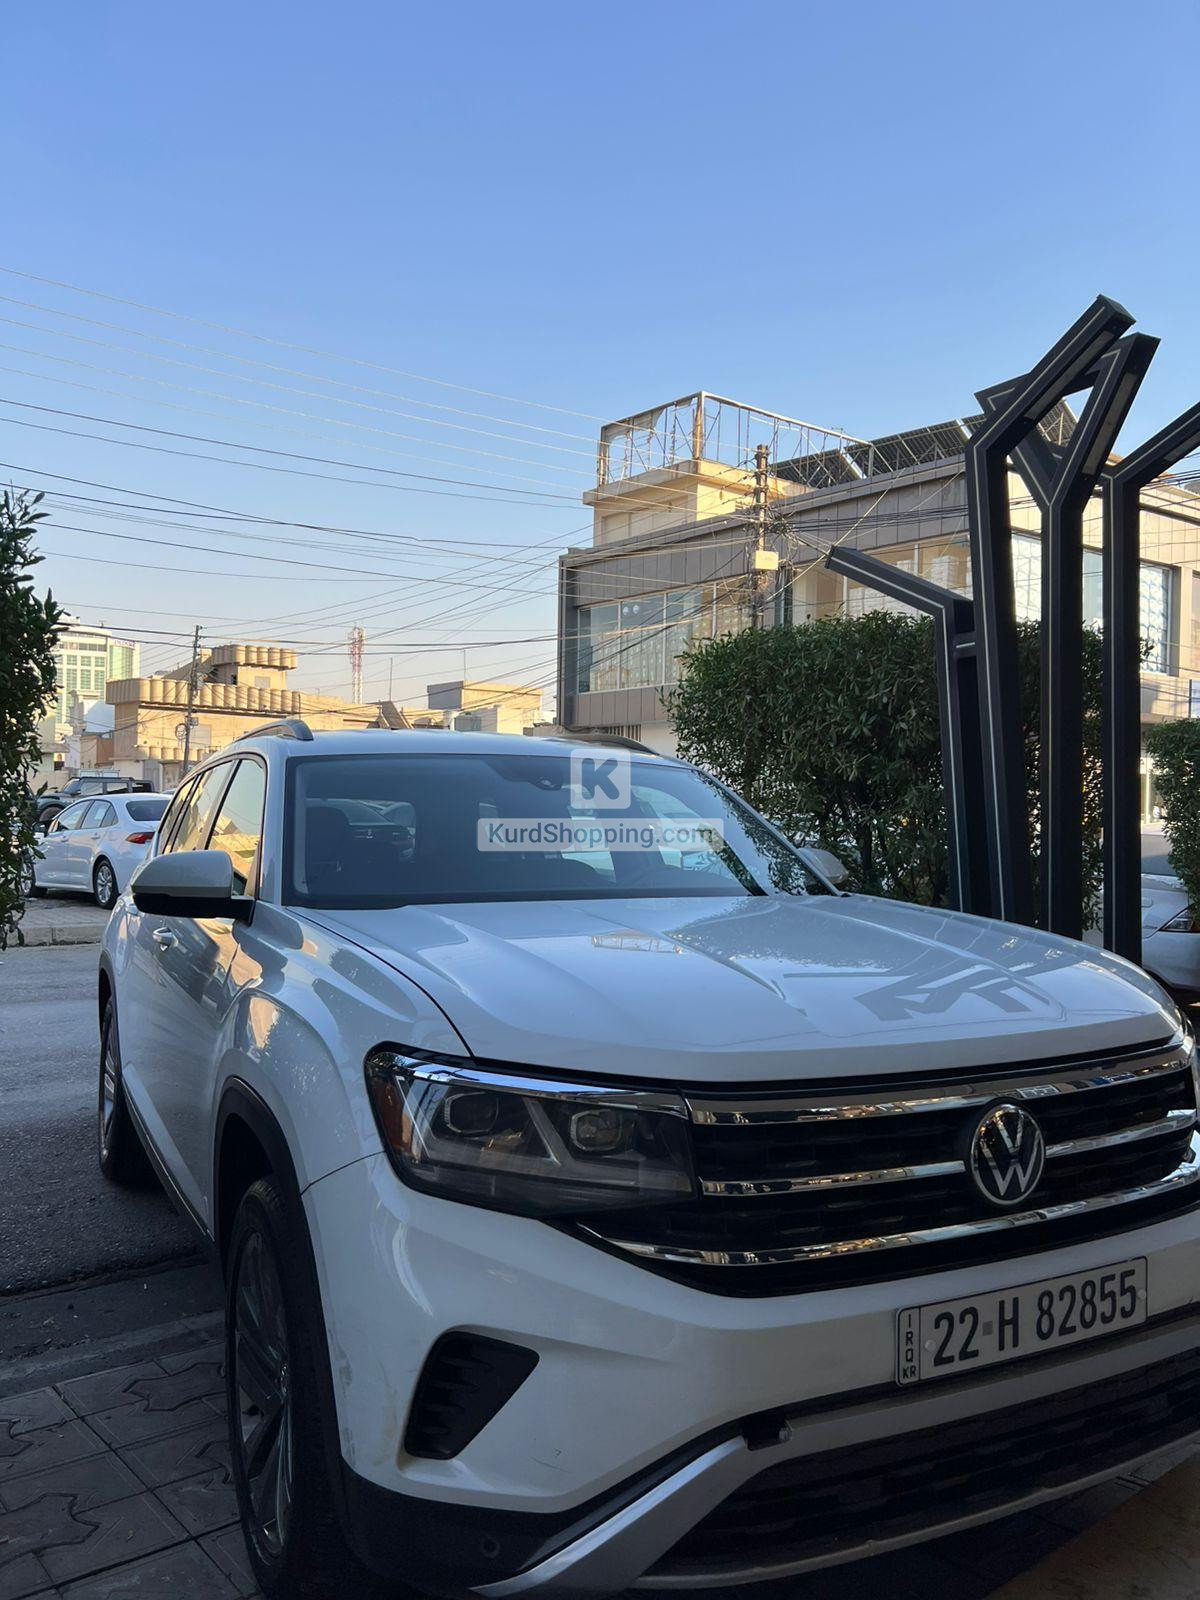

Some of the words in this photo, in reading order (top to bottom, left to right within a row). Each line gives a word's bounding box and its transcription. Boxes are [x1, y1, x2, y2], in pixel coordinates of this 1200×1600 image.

[933, 1306, 979, 1367] 22
[998, 1296, 1019, 1351] H
[1036, 1269, 1136, 1341] 82855
